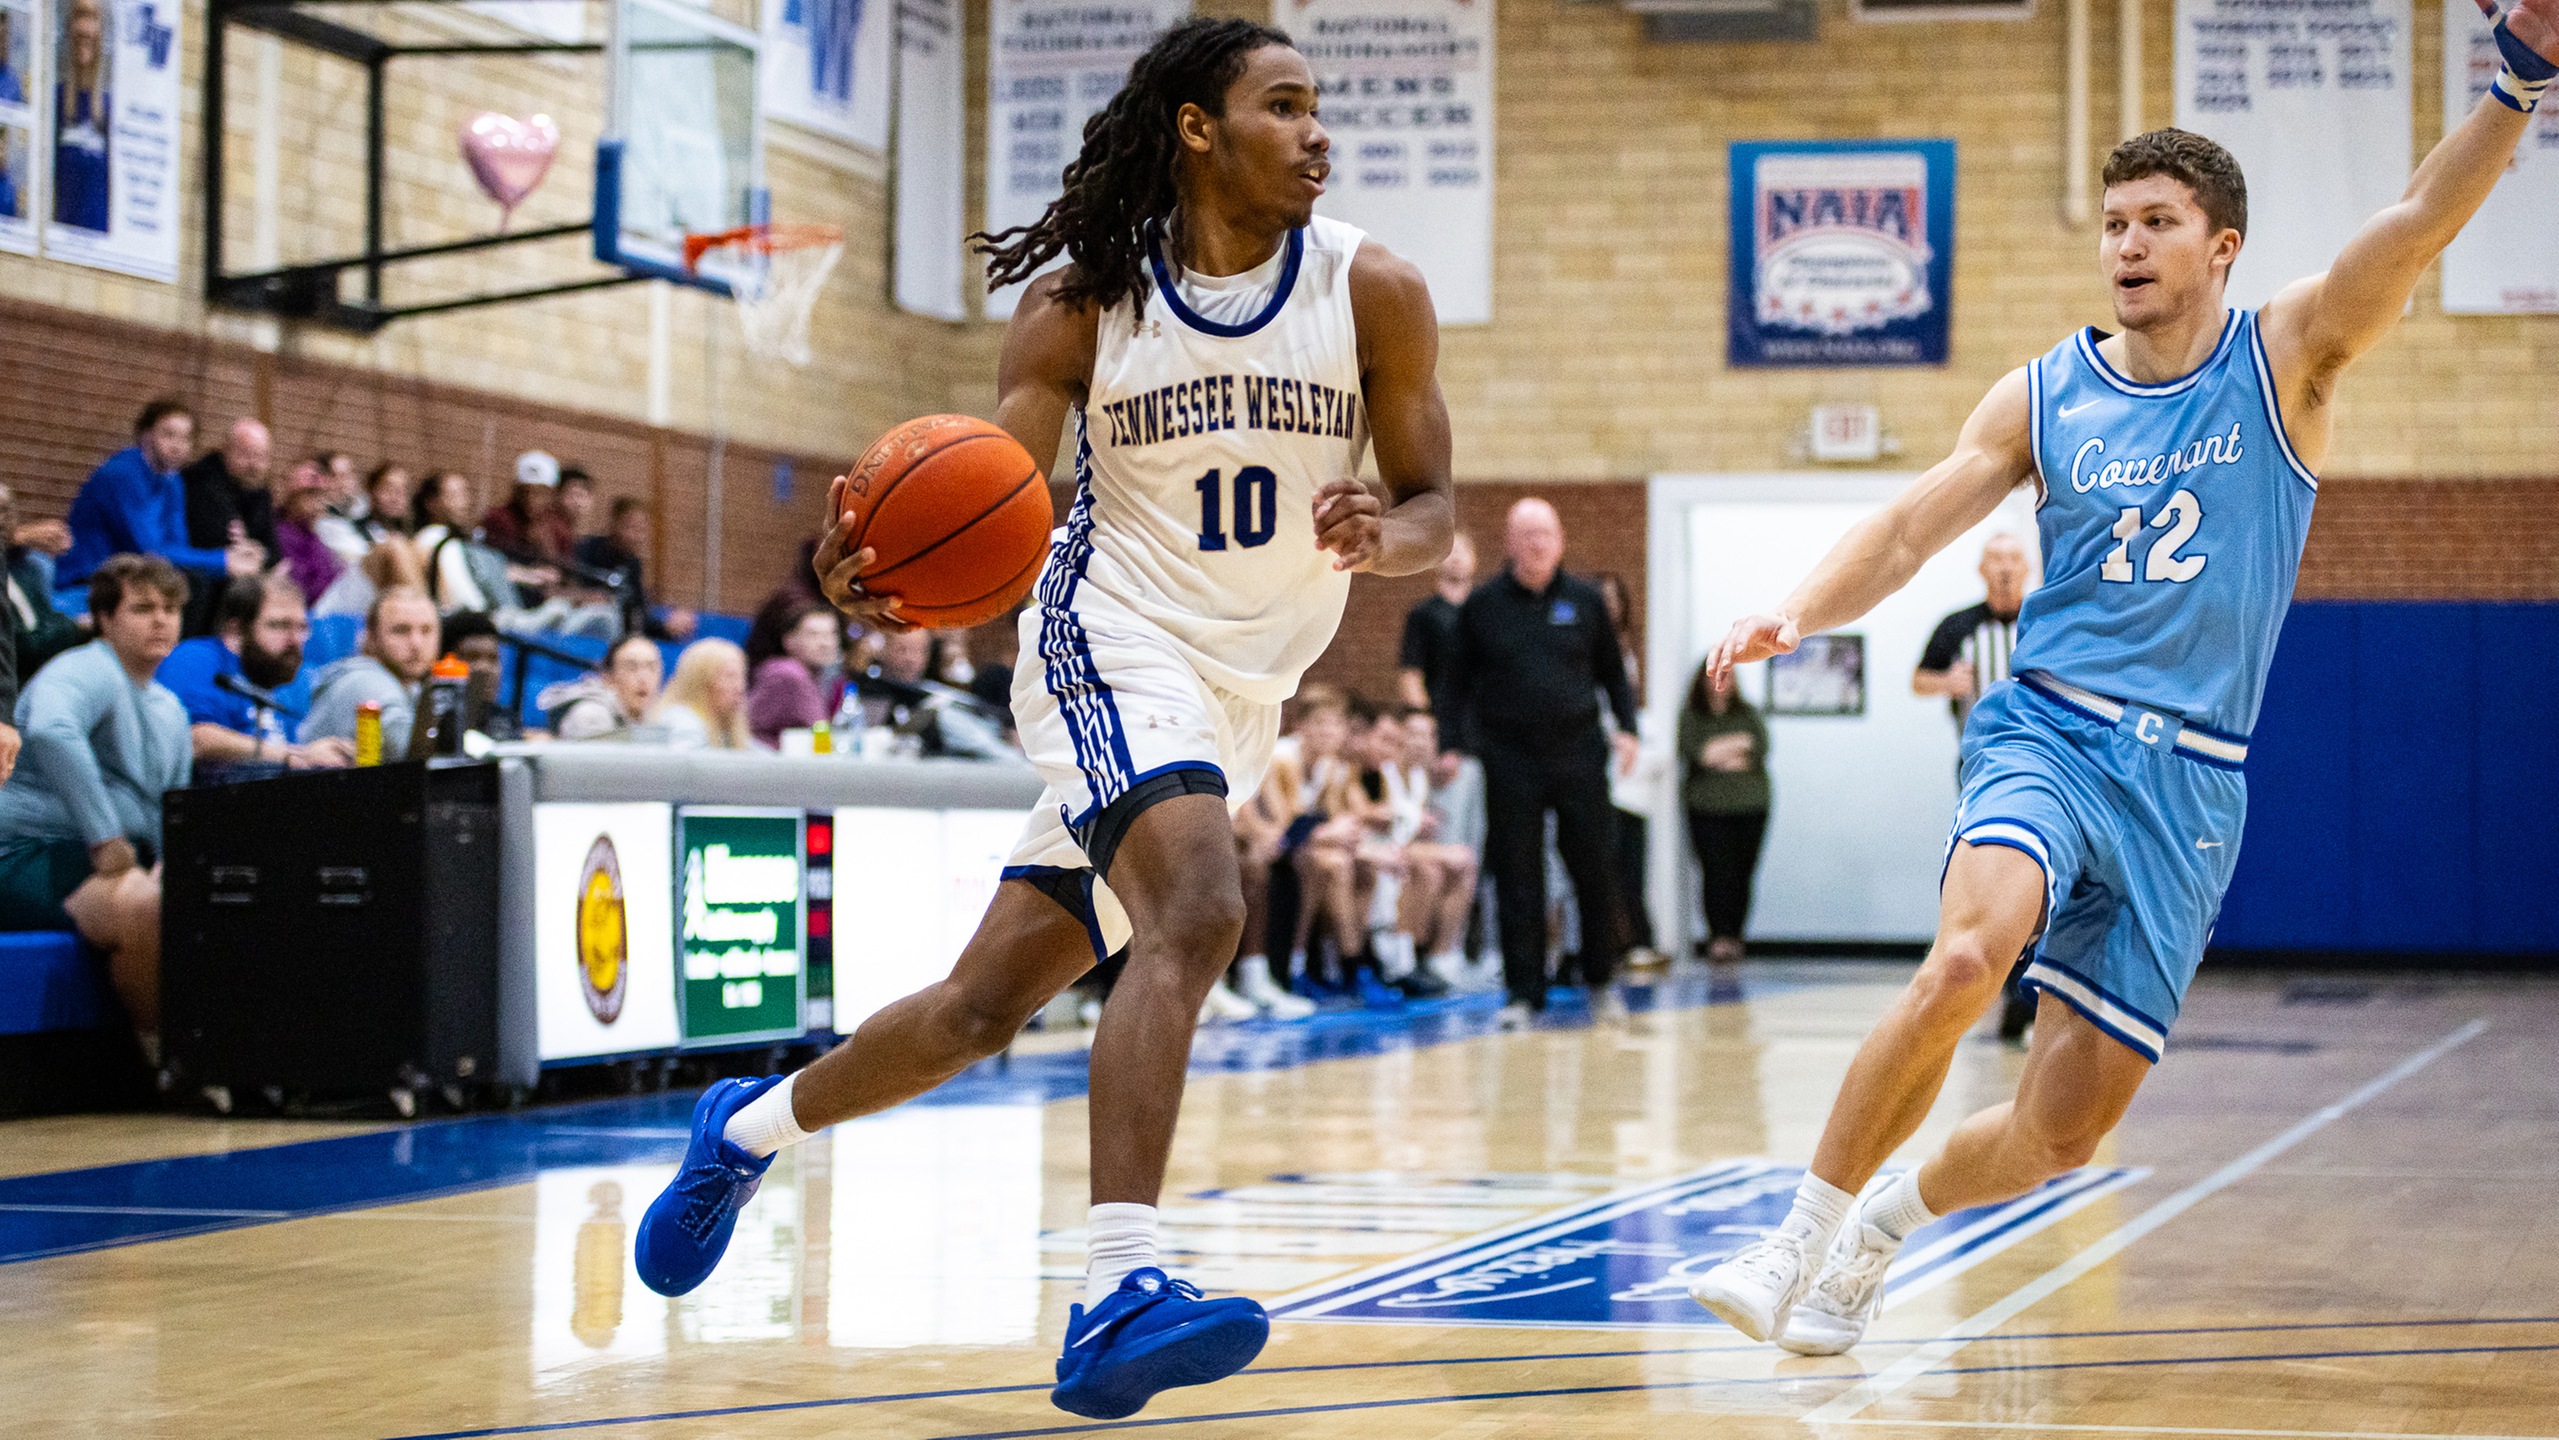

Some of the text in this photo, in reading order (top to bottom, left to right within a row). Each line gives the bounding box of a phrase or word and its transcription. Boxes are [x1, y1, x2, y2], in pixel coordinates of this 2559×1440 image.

[1767, 187, 1910, 241] NAIA
[1102, 374, 1356, 447] TENNESSEE WESLEYAN
[2070, 421, 2244, 494] Covenant
[1193, 465, 1277, 552] 10
[2099, 486, 2207, 584] 12
[2135, 711, 2164, 745] C
